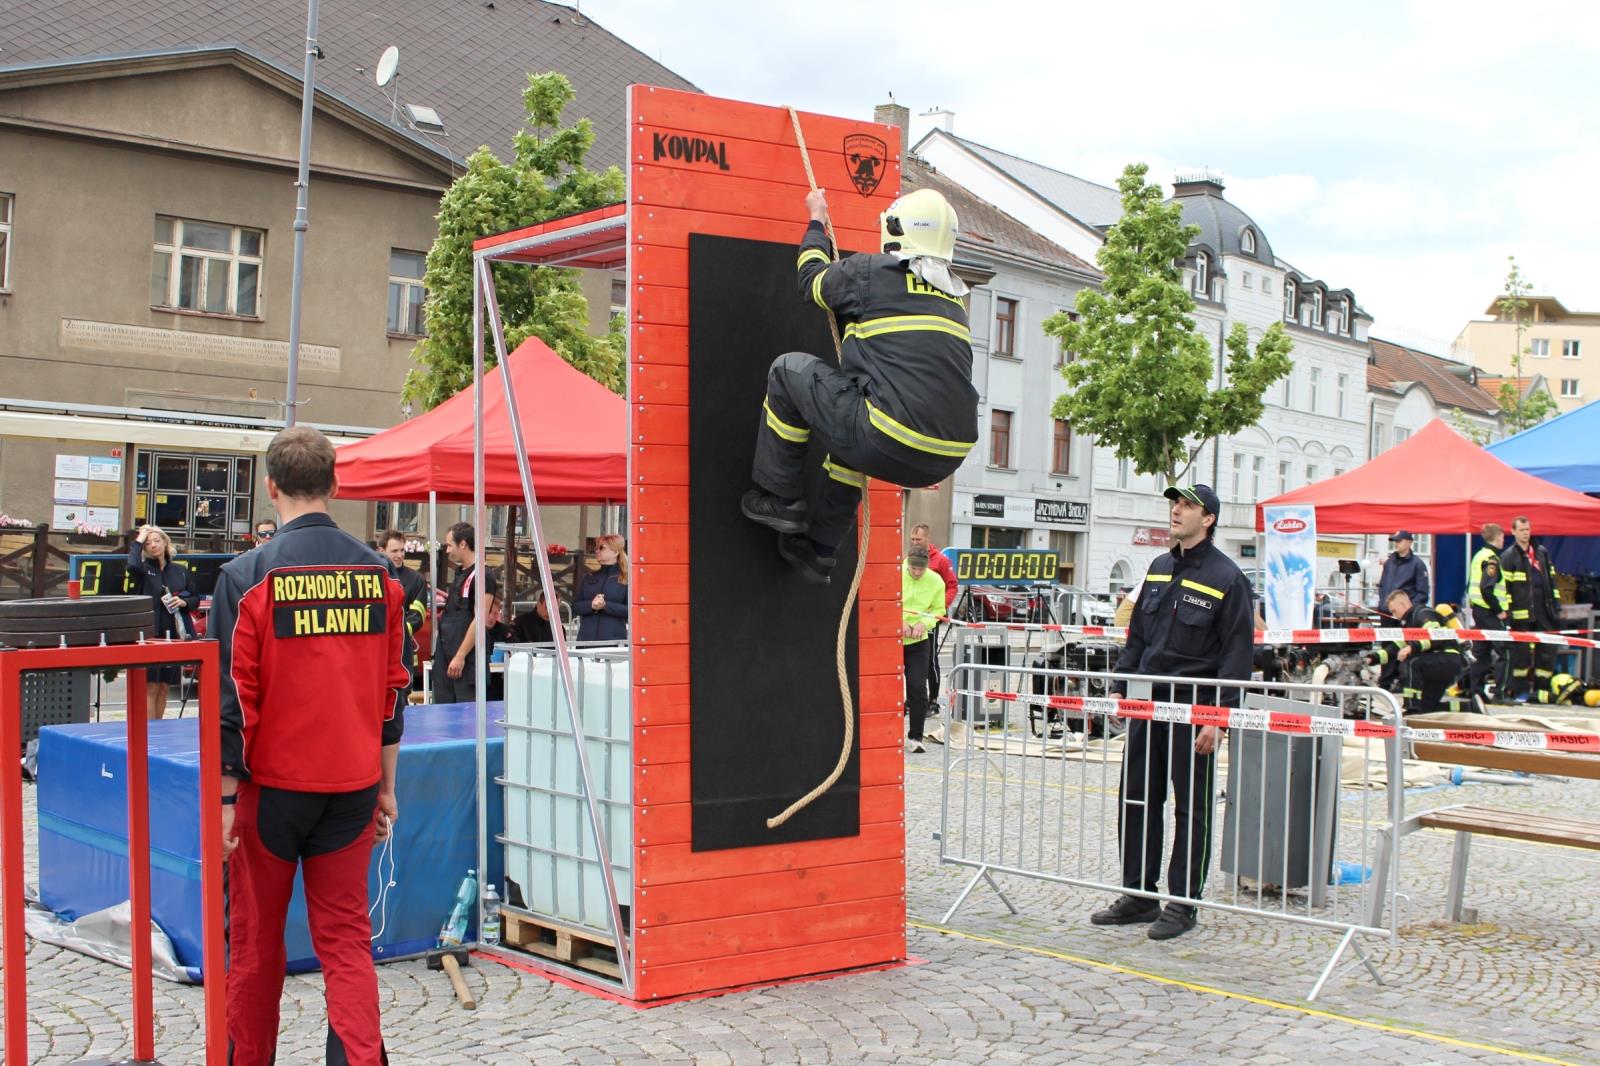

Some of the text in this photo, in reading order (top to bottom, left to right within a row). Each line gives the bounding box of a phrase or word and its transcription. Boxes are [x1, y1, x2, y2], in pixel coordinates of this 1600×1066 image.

[653, 132, 730, 171] KOVPAL
[1036, 501, 1088, 518] JAZYKOVÁ ŠKOLA
[274, 570, 383, 601] ROZHODČÍ TFA
[294, 604, 372, 635] HLAVNÍ
